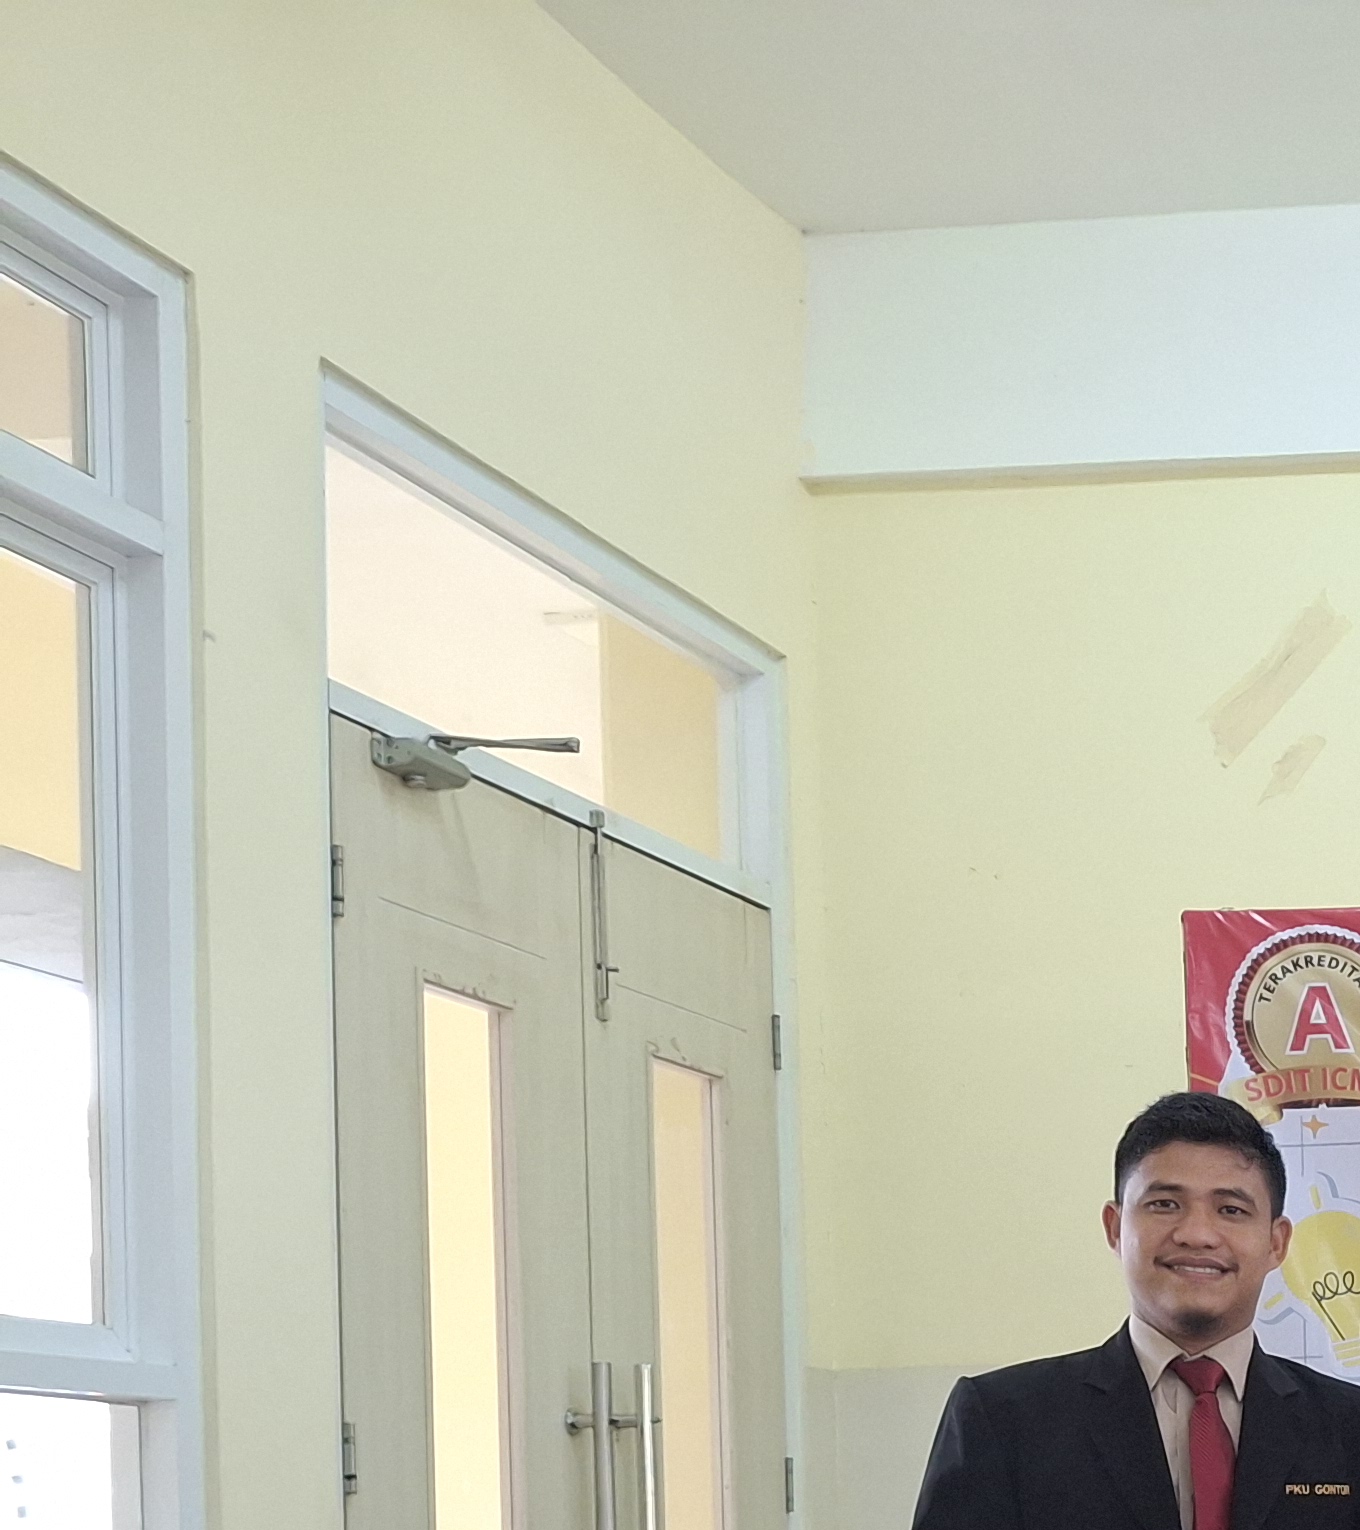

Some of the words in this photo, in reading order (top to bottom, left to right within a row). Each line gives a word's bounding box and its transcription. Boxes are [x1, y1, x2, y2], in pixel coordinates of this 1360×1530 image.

[1286, 983, 1354, 1054] A
[1244, 1068, 1314, 1102] SDIT
[1285, 1484, 1310, 1495] PKU
